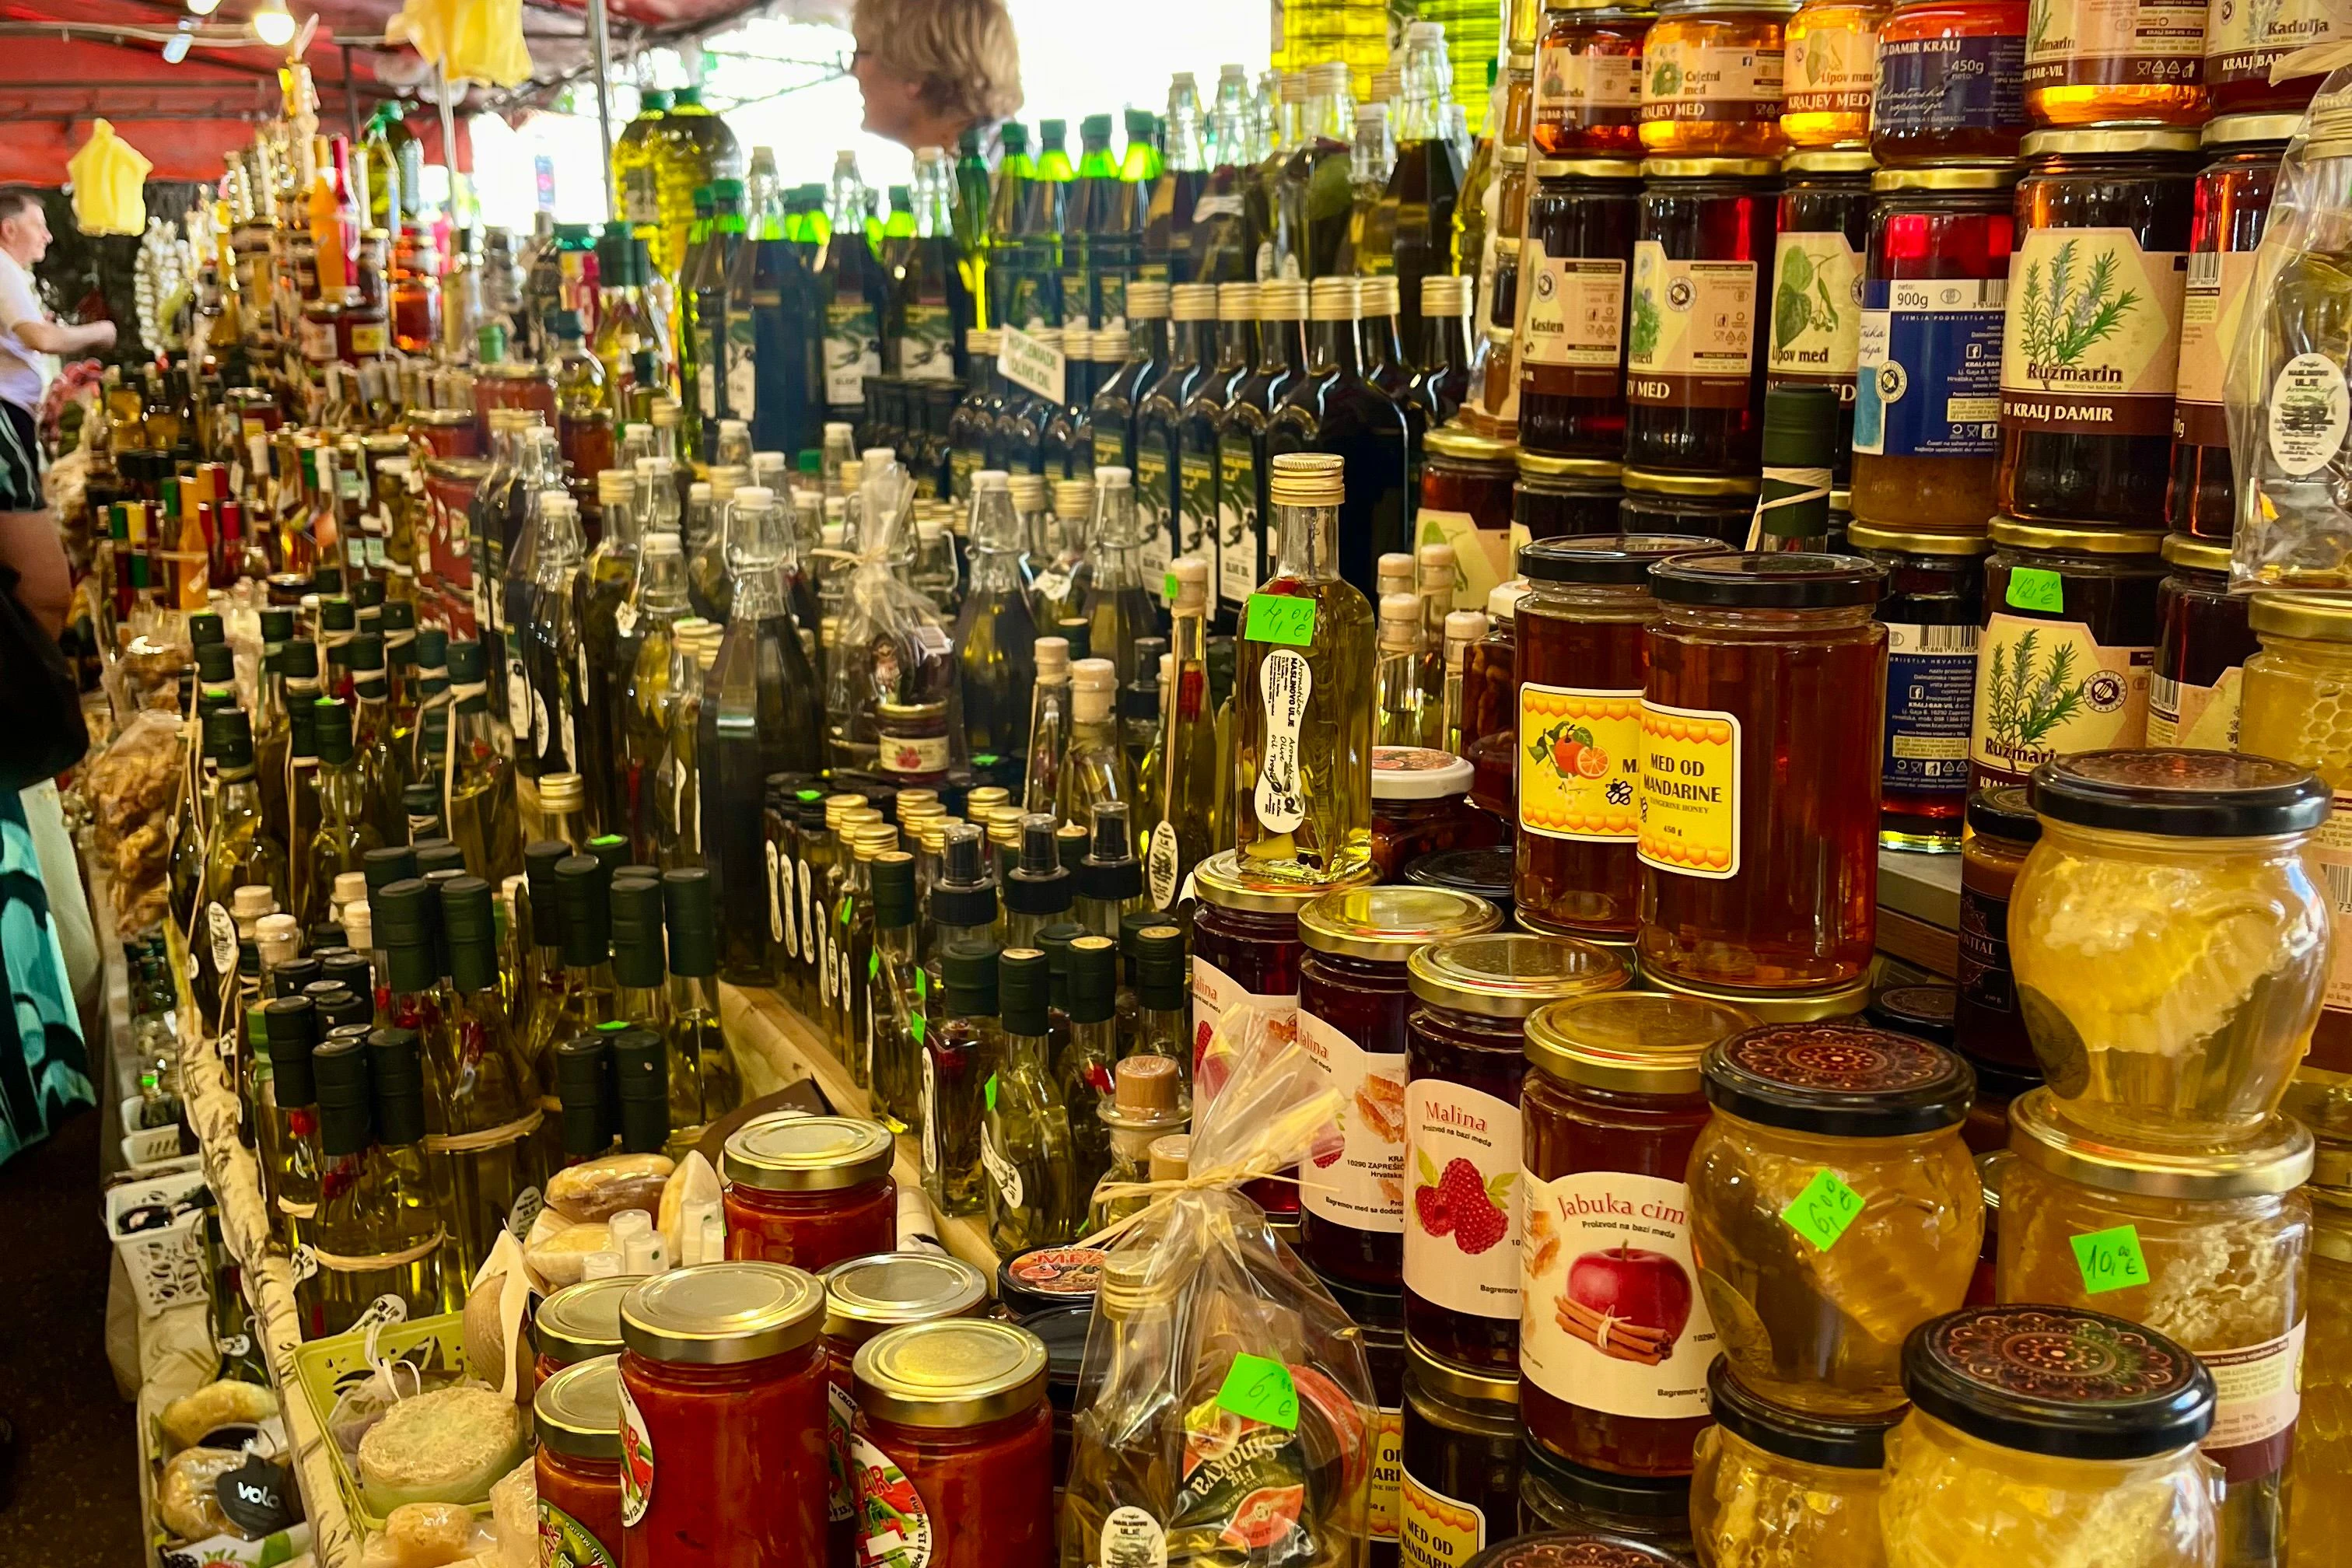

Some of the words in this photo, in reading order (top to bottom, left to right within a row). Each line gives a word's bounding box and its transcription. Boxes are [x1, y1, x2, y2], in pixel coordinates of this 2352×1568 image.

[2267, 19, 2329, 36] Kadulja
[1888, 41, 1920, 56] DAMIR
[1923, 40, 1961, 54] KRALJ
[1951, 59, 1984, 74] 450g
[2222, 54, 2254, 72] KRALJ
[1675, 103, 1706, 117] MED
[1789, 93, 1832, 110] KRALJEV
[1836, 93, 1871, 107] MED
[1898, 292, 1928, 310] 900g
[1772, 346, 1796, 364] Lipov
[1798, 346, 1829, 363] med
[2027, 362, 2123, 383] Ružmarin
[1637, 382, 1670, 399] MED
[2013, 402, 2050, 422] KRALJ
[2053, 405, 2113, 422] DAMIR
[1288, 657, 1298, 705] MASLINOVO
[1985, 736, 2056, 764] Ružmari
[1650, 752, 1675, 772] MED
[1680, 759, 1705, 777] OD
[1643, 773, 1723, 803] MANDARINE
[1682, 803, 1710, 814] HONEY
[1425, 1100, 1488, 1133] Malina
[1557, 1192, 1633, 1222] Jabuka
[1640, 1199, 1685, 1225] cim
[1633, 1223, 1650, 1234] bazi
[1480, 1284, 1518, 1294] Bagremov
[1191, 1433, 1279, 1496] Smokva
[1225, 1464, 1257, 1488] Fig
[1407, 1516, 1429, 1544] MED
[1432, 1536, 1454, 1556] OD
